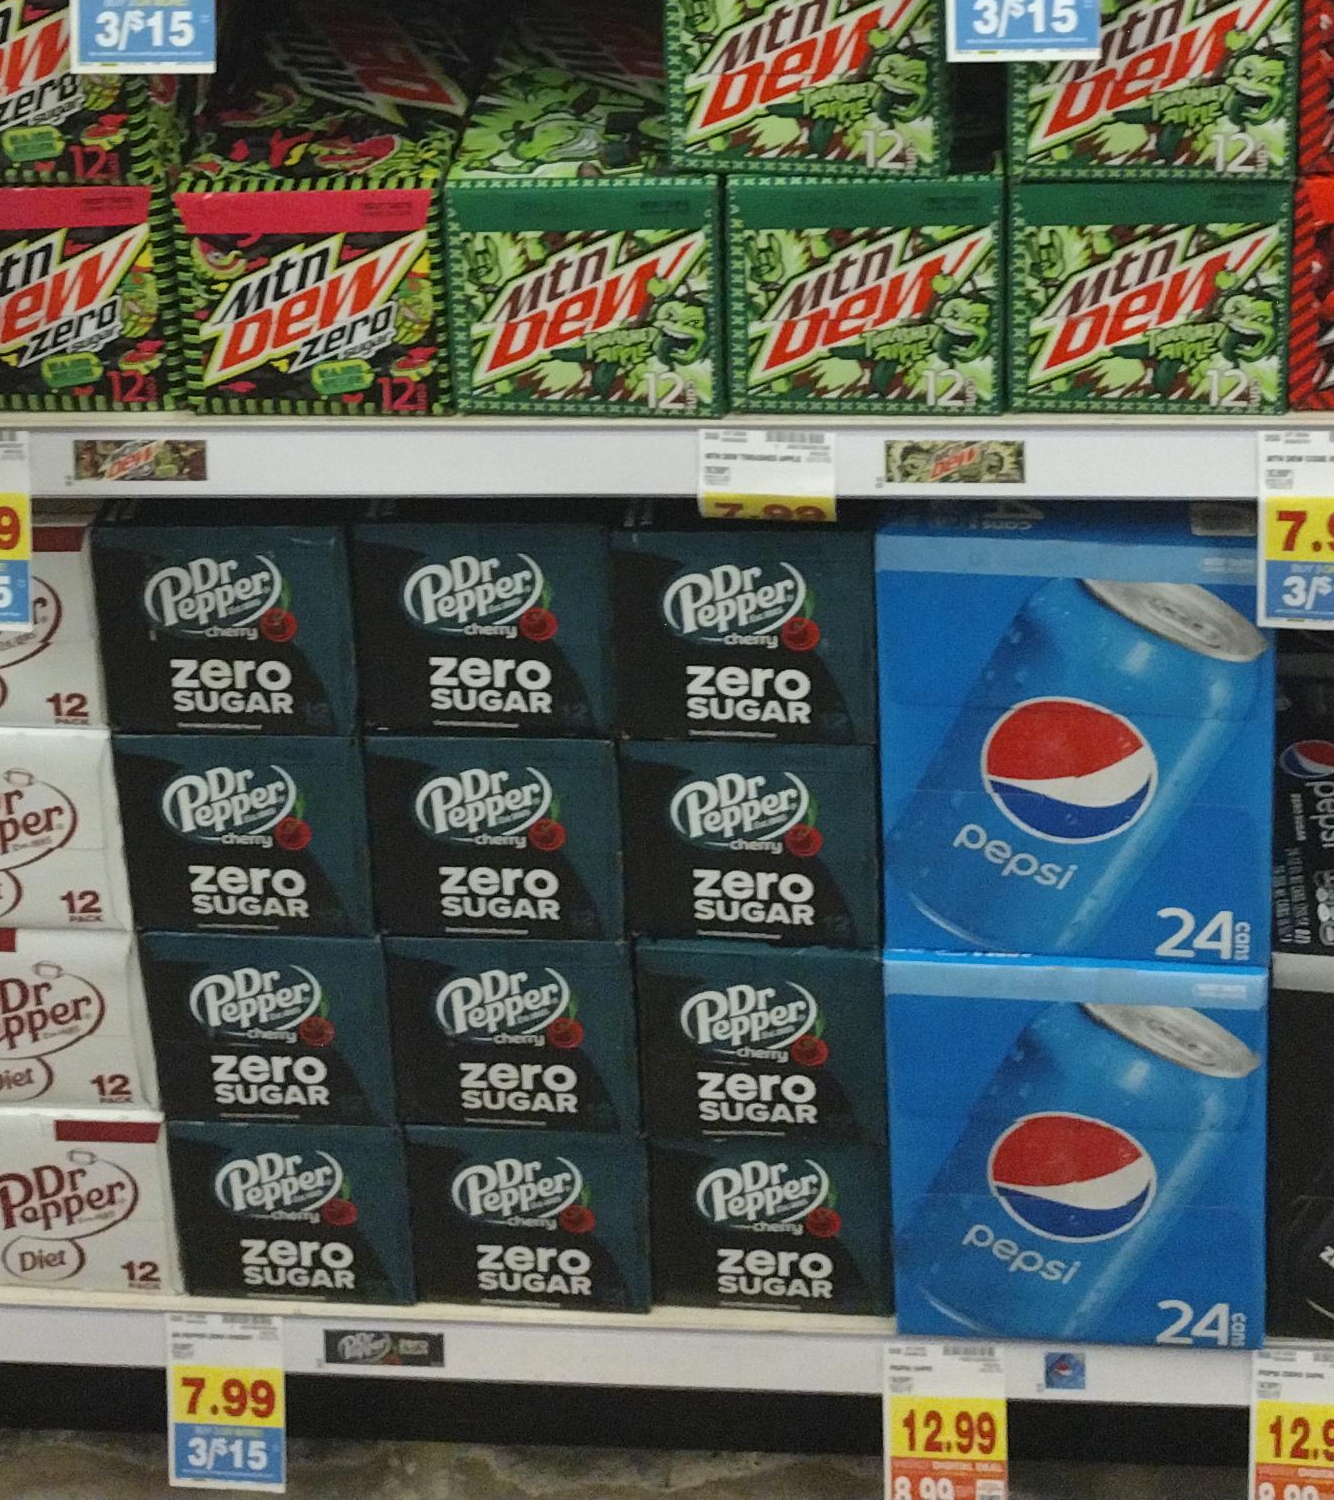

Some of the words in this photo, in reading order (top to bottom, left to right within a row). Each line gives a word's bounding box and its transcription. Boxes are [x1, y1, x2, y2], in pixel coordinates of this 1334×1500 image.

[863, 130, 905, 169] 12
[29, 300, 117, 360] zero
[108, 370, 148, 402] 12
[187, 558, 238, 594] Dr
[147, 567, 270, 627] Pepper
[170, 659, 292, 691] zero
[173, 691, 293, 714] SUGAR
[953, 822, 1078, 892] pepsi
[61, 890, 100, 914] 12
[693, 867, 814, 902] zero
[694, 898, 815, 925] SUGAR
[1156, 907, 1234, 961] 24
[963, 1222, 1082, 1285] pepsi
[181, 1377, 276, 1418] 7.99
[903, 1409, 996, 1454] 12.99
